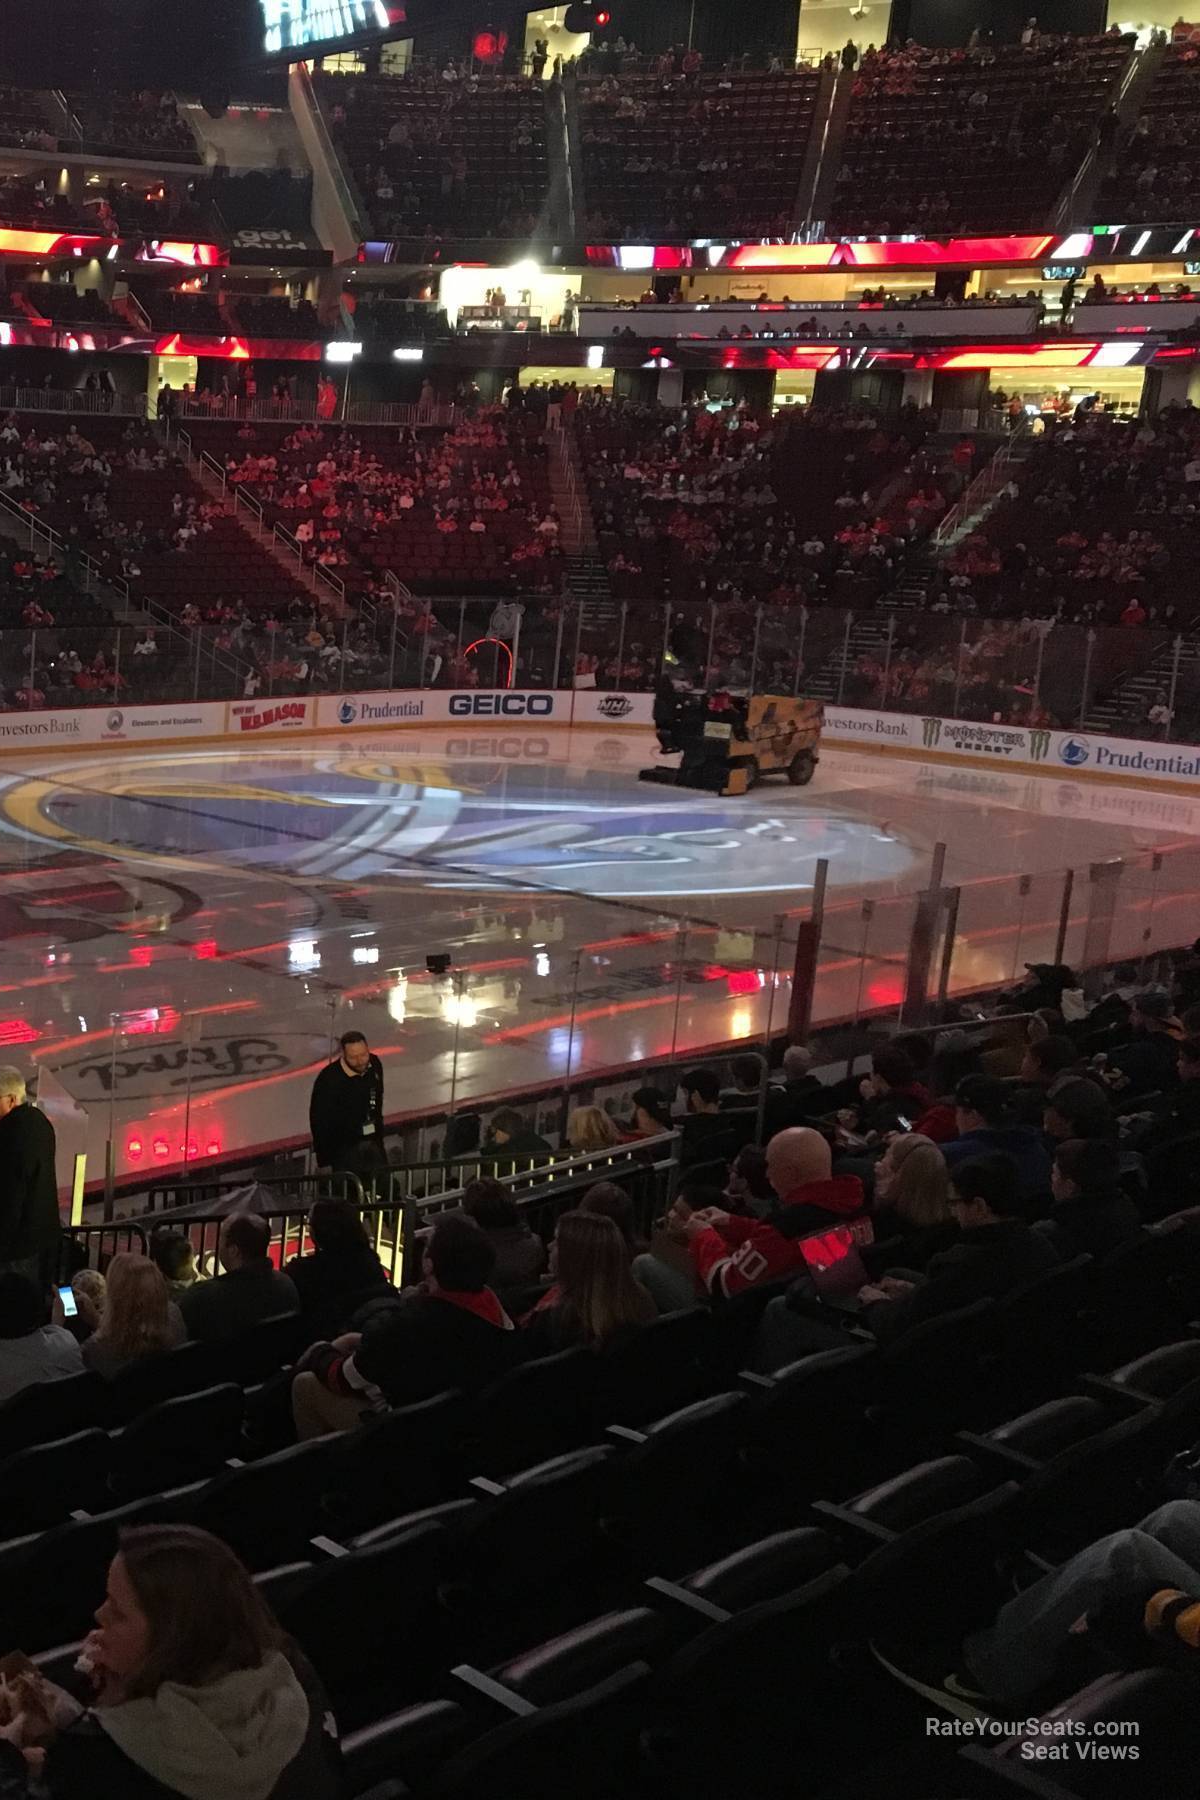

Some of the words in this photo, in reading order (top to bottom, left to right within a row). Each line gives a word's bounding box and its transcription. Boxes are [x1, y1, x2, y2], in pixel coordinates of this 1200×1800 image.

[237, 229, 292, 242] get
[361, 700, 424, 719] Prudential
[449, 695, 554, 715] GEICO
[1096, 746, 1200, 776] Prudential
[78, 1038, 291, 1091] Ford
